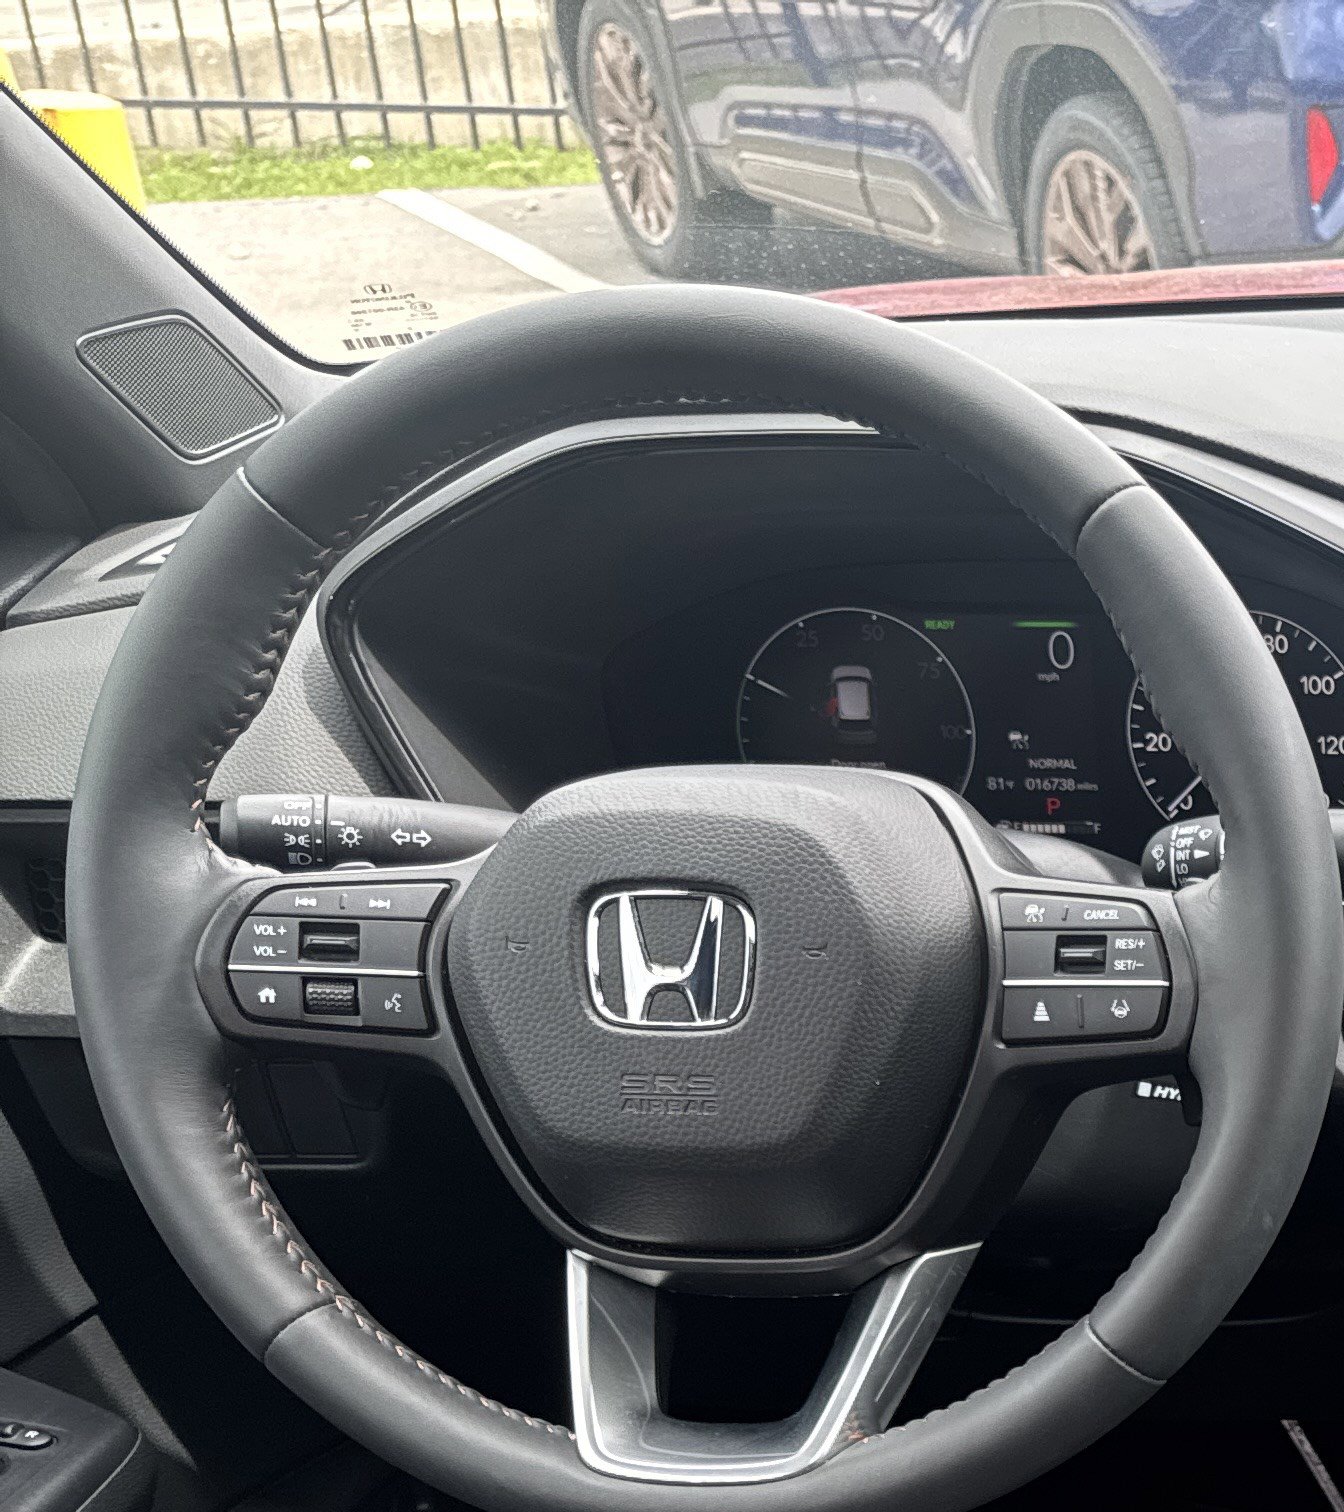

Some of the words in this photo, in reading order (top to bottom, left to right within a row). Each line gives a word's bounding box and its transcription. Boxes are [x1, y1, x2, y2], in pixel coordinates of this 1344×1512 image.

[923, 619, 956, 631] READY
[1048, 631, 1075, 670] 0
[1299, 675, 1335, 696] 100
[1144, 732, 1172, 753] 20
[1028, 758, 1077, 770] NORMAL
[1024, 778, 1075, 791] 016738
[1047, 797, 1060, 816] P
[271, 814, 311, 827] AUTO
[1175, 837, 1194, 848] OFF
[1083, 909, 1119, 920] CANCEL
[620, 1073, 715, 1096] SRS
[1152, 1085, 1182, 1101] HY
